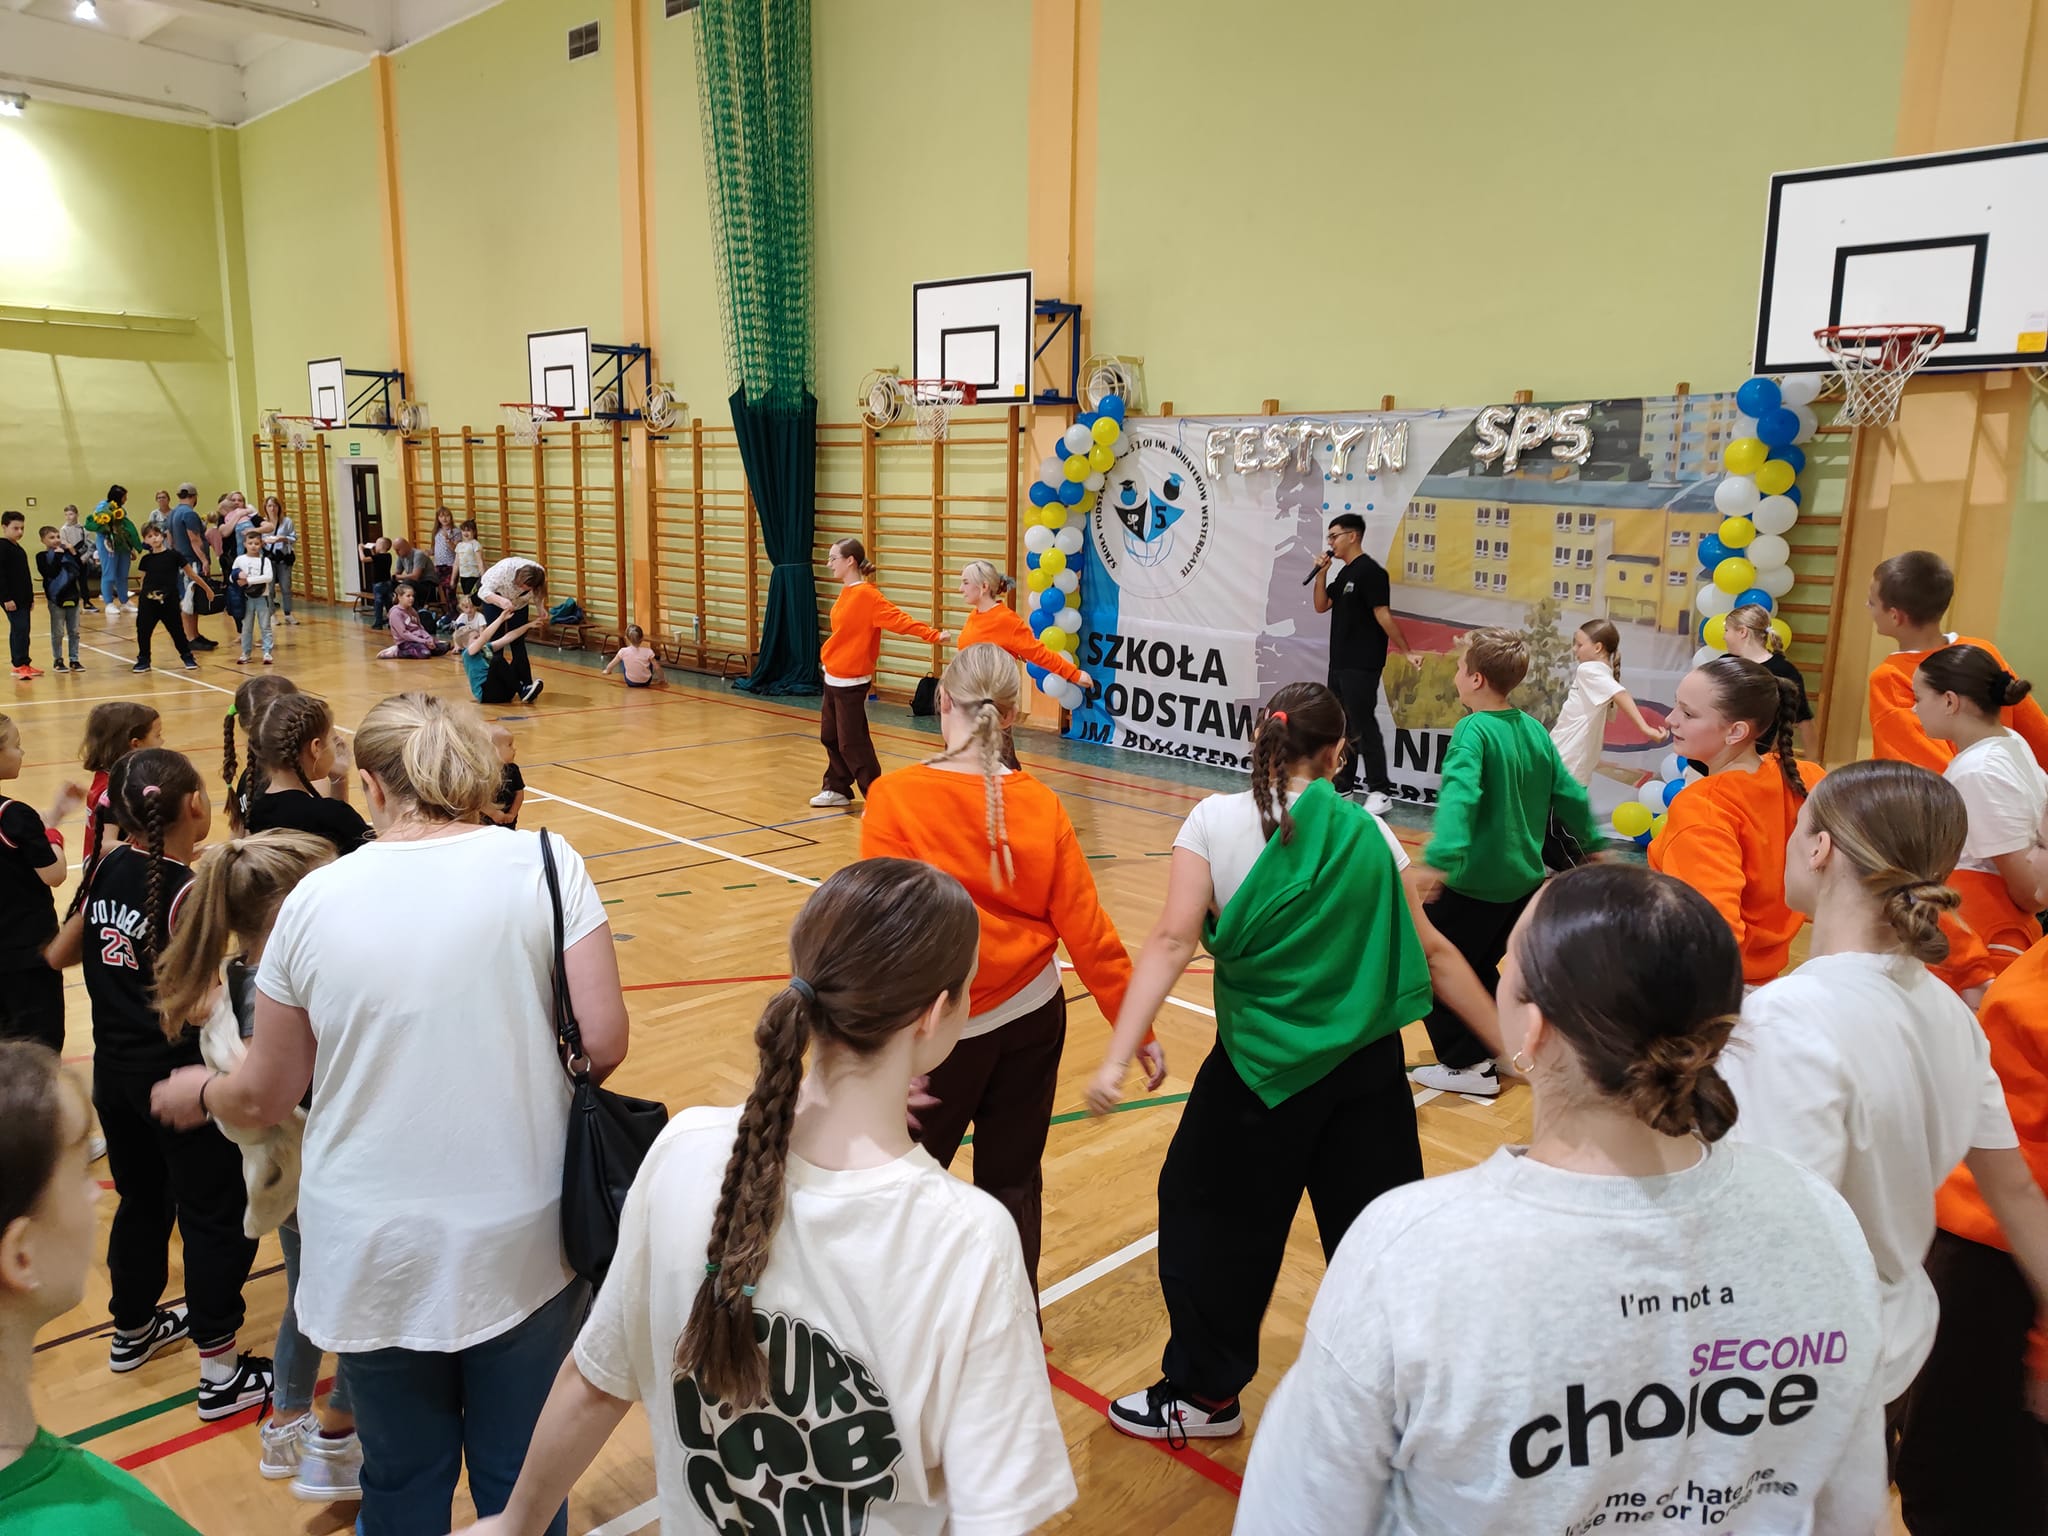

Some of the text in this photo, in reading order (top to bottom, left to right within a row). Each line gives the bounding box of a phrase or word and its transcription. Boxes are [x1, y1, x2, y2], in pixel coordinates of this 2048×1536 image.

[1206, 418, 1409, 482] FESTYN
[1155, 506, 1167, 529] 5
[1180, 504, 1209, 578] WESTERPLATTE
[1087, 631, 1228, 687] SZKOŁA
[1620, 1284, 1735, 1318] I'm not a
[1688, 1331, 1848, 1377] SECOND
[1509, 1373, 1819, 1480] choice
[1605, 1492, 1647, 1507] me
[1663, 1504, 1692, 1520] or
